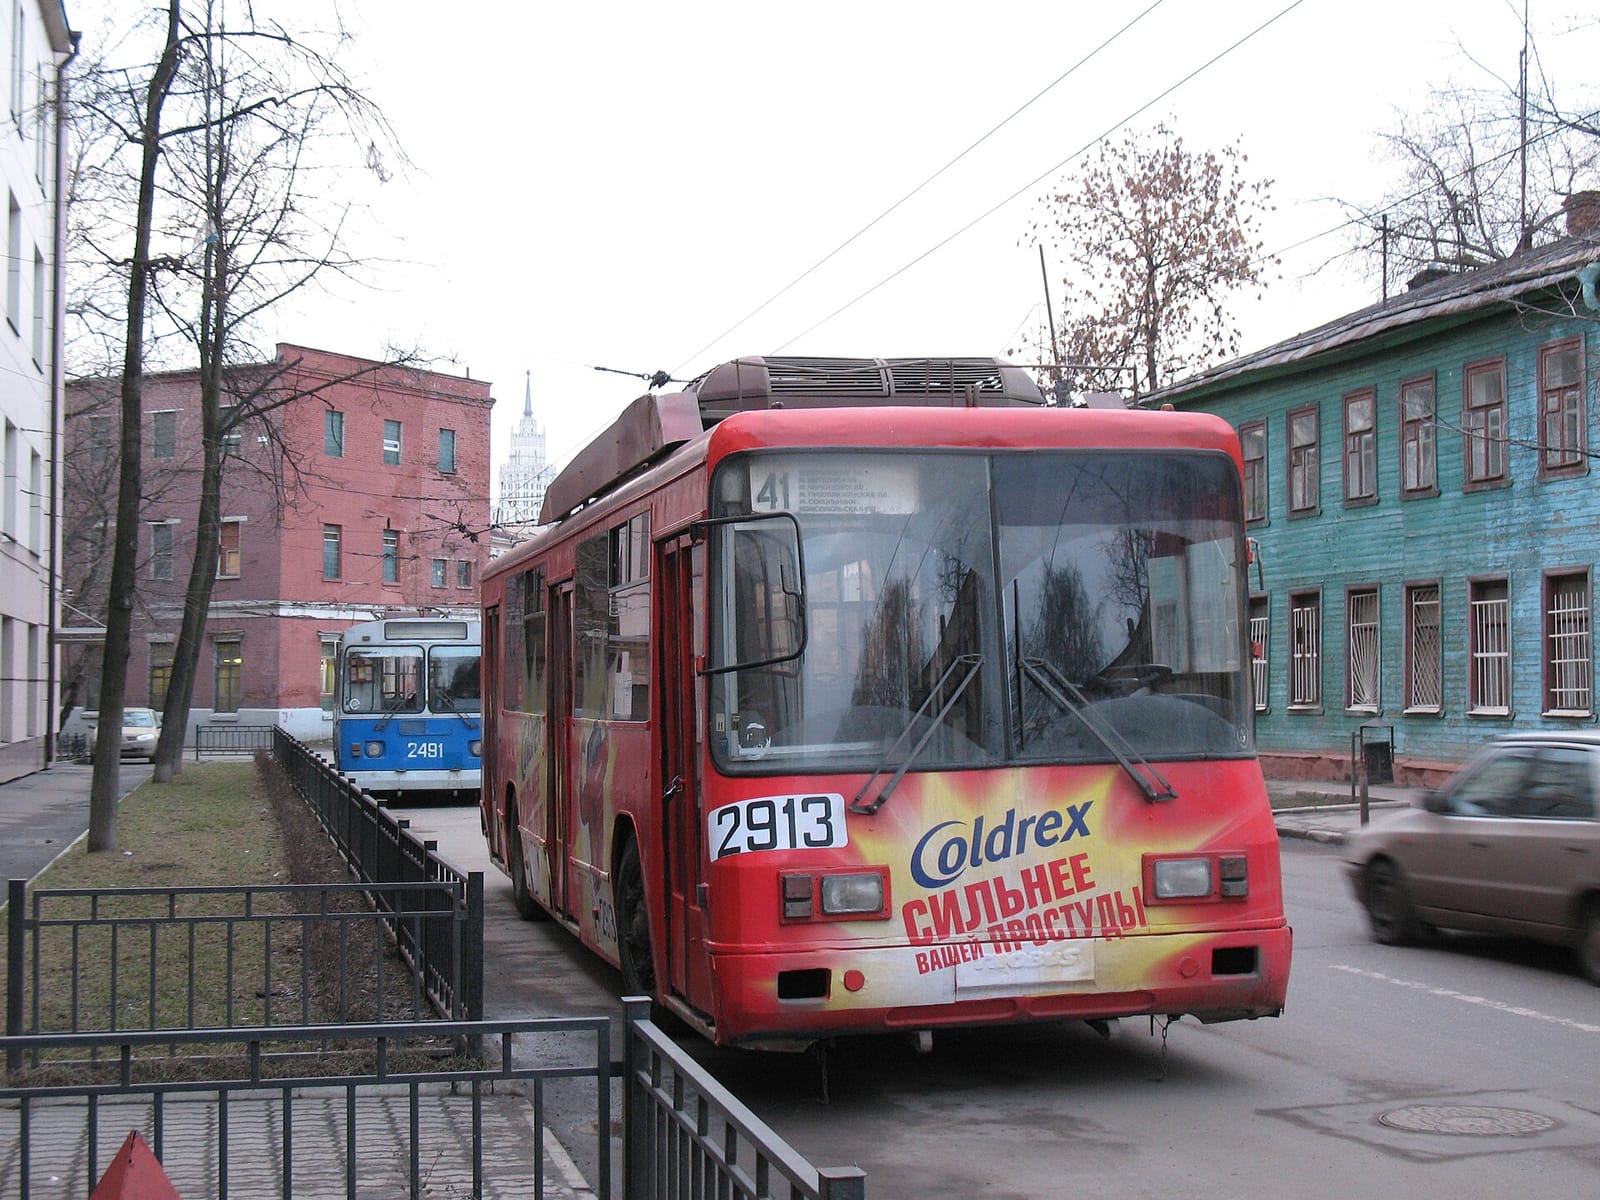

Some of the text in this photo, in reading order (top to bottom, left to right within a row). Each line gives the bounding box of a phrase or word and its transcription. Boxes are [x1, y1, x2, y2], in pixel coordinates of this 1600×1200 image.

[757, 472, 790, 509] 41
[407, 742, 444, 758] 2491
[717, 796, 834, 859] 2913
[911, 800, 1094, 889] Coldrex
[902, 852, 1096, 946] СИЛЬНЕЕ
[915, 935, 984, 975] ВАШЕЙ
[987, 886, 1147, 954] ПРОСТУДЫ
